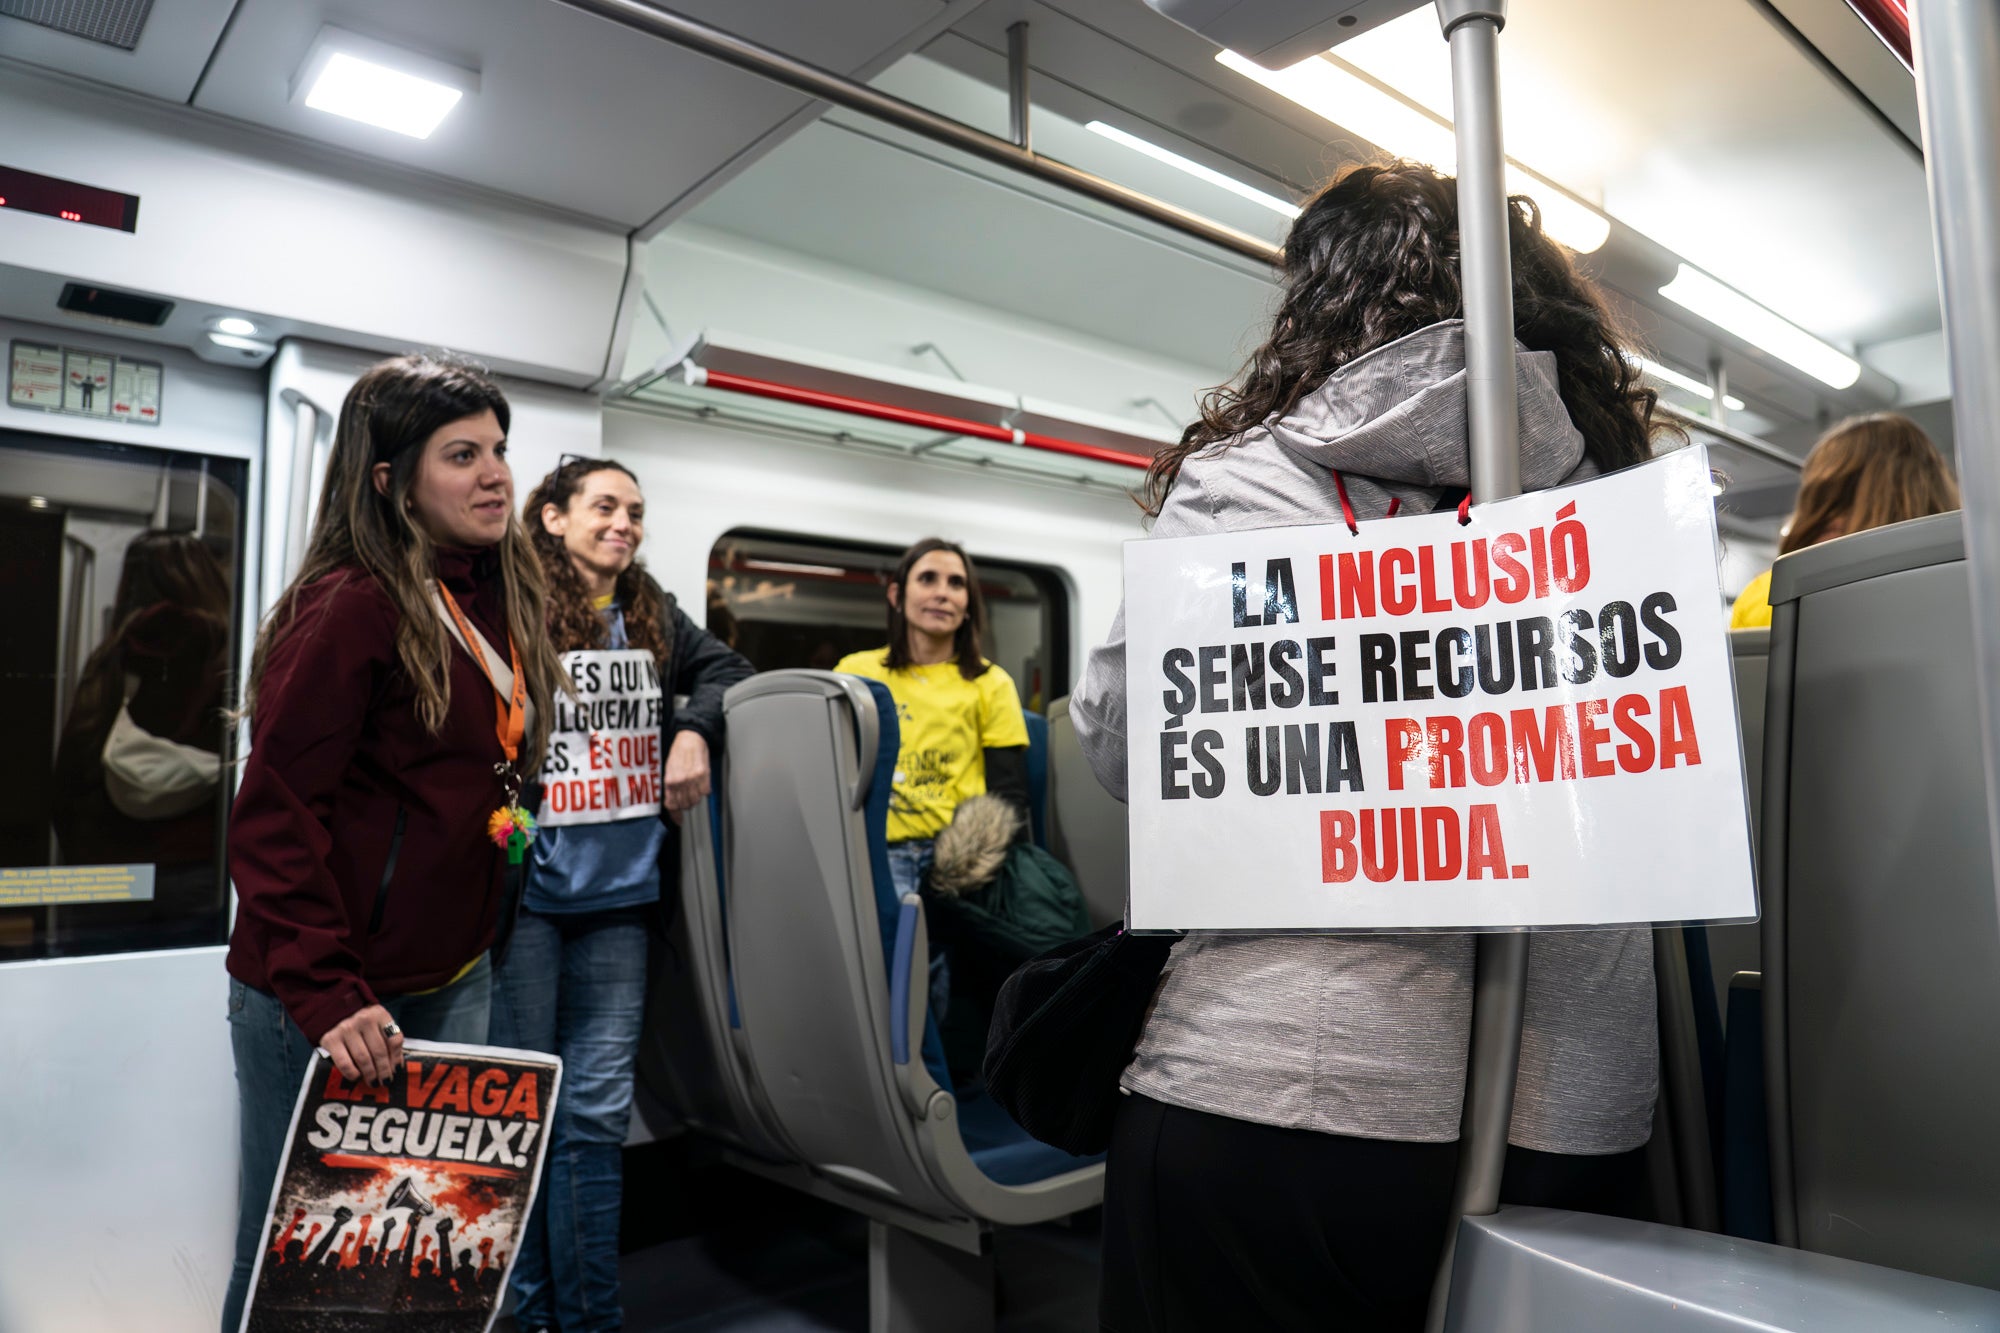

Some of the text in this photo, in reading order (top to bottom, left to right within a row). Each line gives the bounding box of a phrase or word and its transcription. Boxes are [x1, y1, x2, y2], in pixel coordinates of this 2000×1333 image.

[1231, 500, 1591, 628] LA INCLUSIÓ
[1162, 591, 1683, 716] SENSE RECURSOS
[558, 699, 640, 732] LGUEM
[618, 734, 659, 769] QUE
[1160, 685, 1702, 800] ÉS UNA PROMESA
[1320, 803, 1529, 885] BUIDA.
[405, 1060, 540, 1121] VAGA
[307, 1102, 541, 1168] SEGUEIX!
